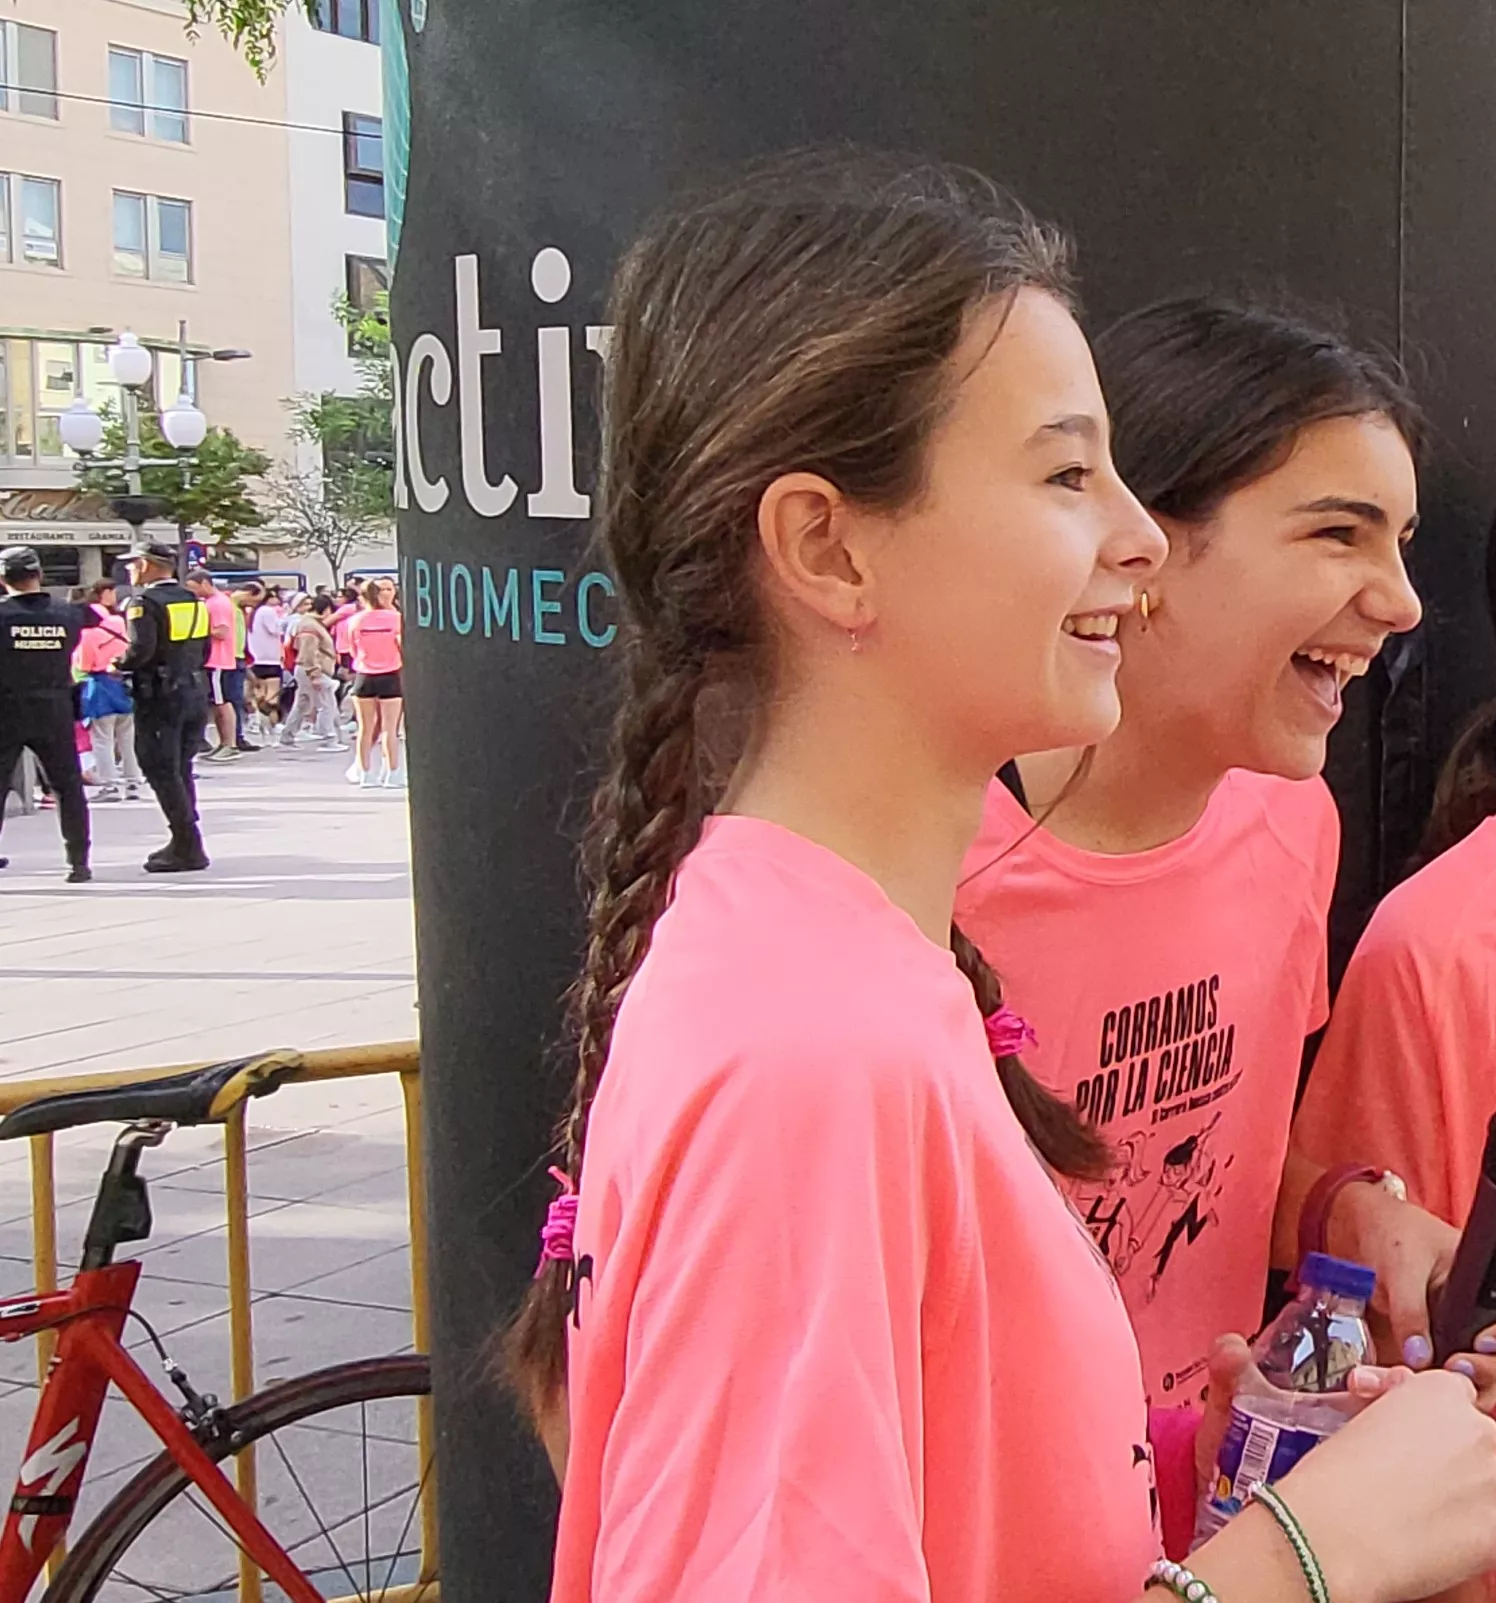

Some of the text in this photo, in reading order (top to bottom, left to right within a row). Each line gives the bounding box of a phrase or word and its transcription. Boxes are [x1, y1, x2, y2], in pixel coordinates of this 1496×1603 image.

[390, 247, 616, 518] cti
[11, 626, 66, 638] POLICIA
[1100, 974, 1219, 1068] CORRAMOS
[1076, 1069, 1120, 1126] POR
[1122, 1057, 1149, 1117] LA
[1153, 1023, 1235, 1105] CIENCIA
